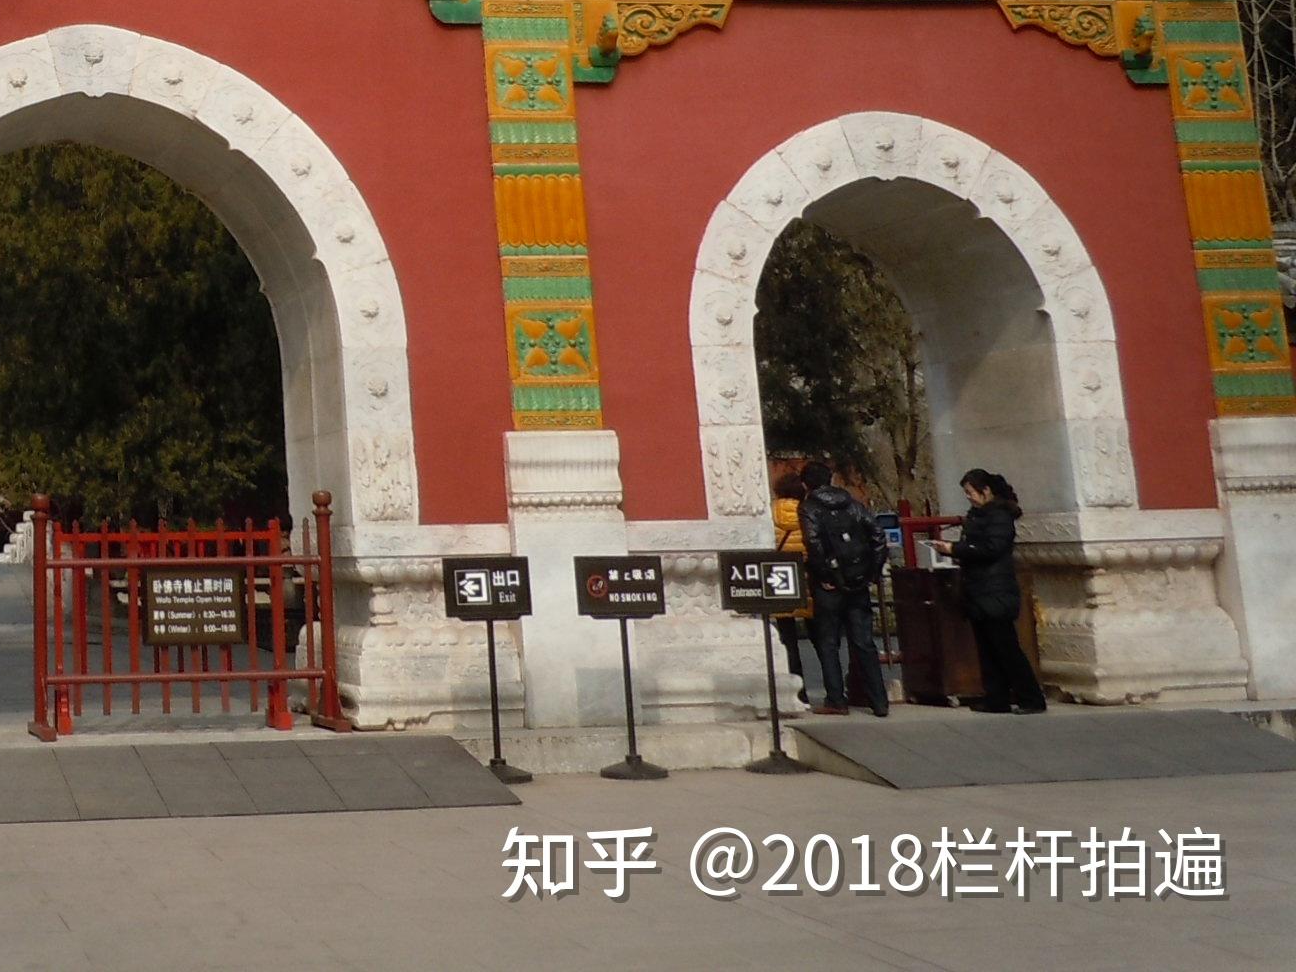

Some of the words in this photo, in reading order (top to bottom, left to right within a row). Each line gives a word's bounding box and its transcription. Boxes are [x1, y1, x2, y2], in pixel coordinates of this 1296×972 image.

[492, 570, 520, 586] 出口
[731, 564, 759, 580] 入口
[498, 590, 516, 603] Exit
[608, 592, 619, 602] NO
[730, 585, 762, 598] Entrance
[172, 596, 194, 604] Temple
[195, 595, 212, 603] Open
[213, 595, 232, 603] Hours
